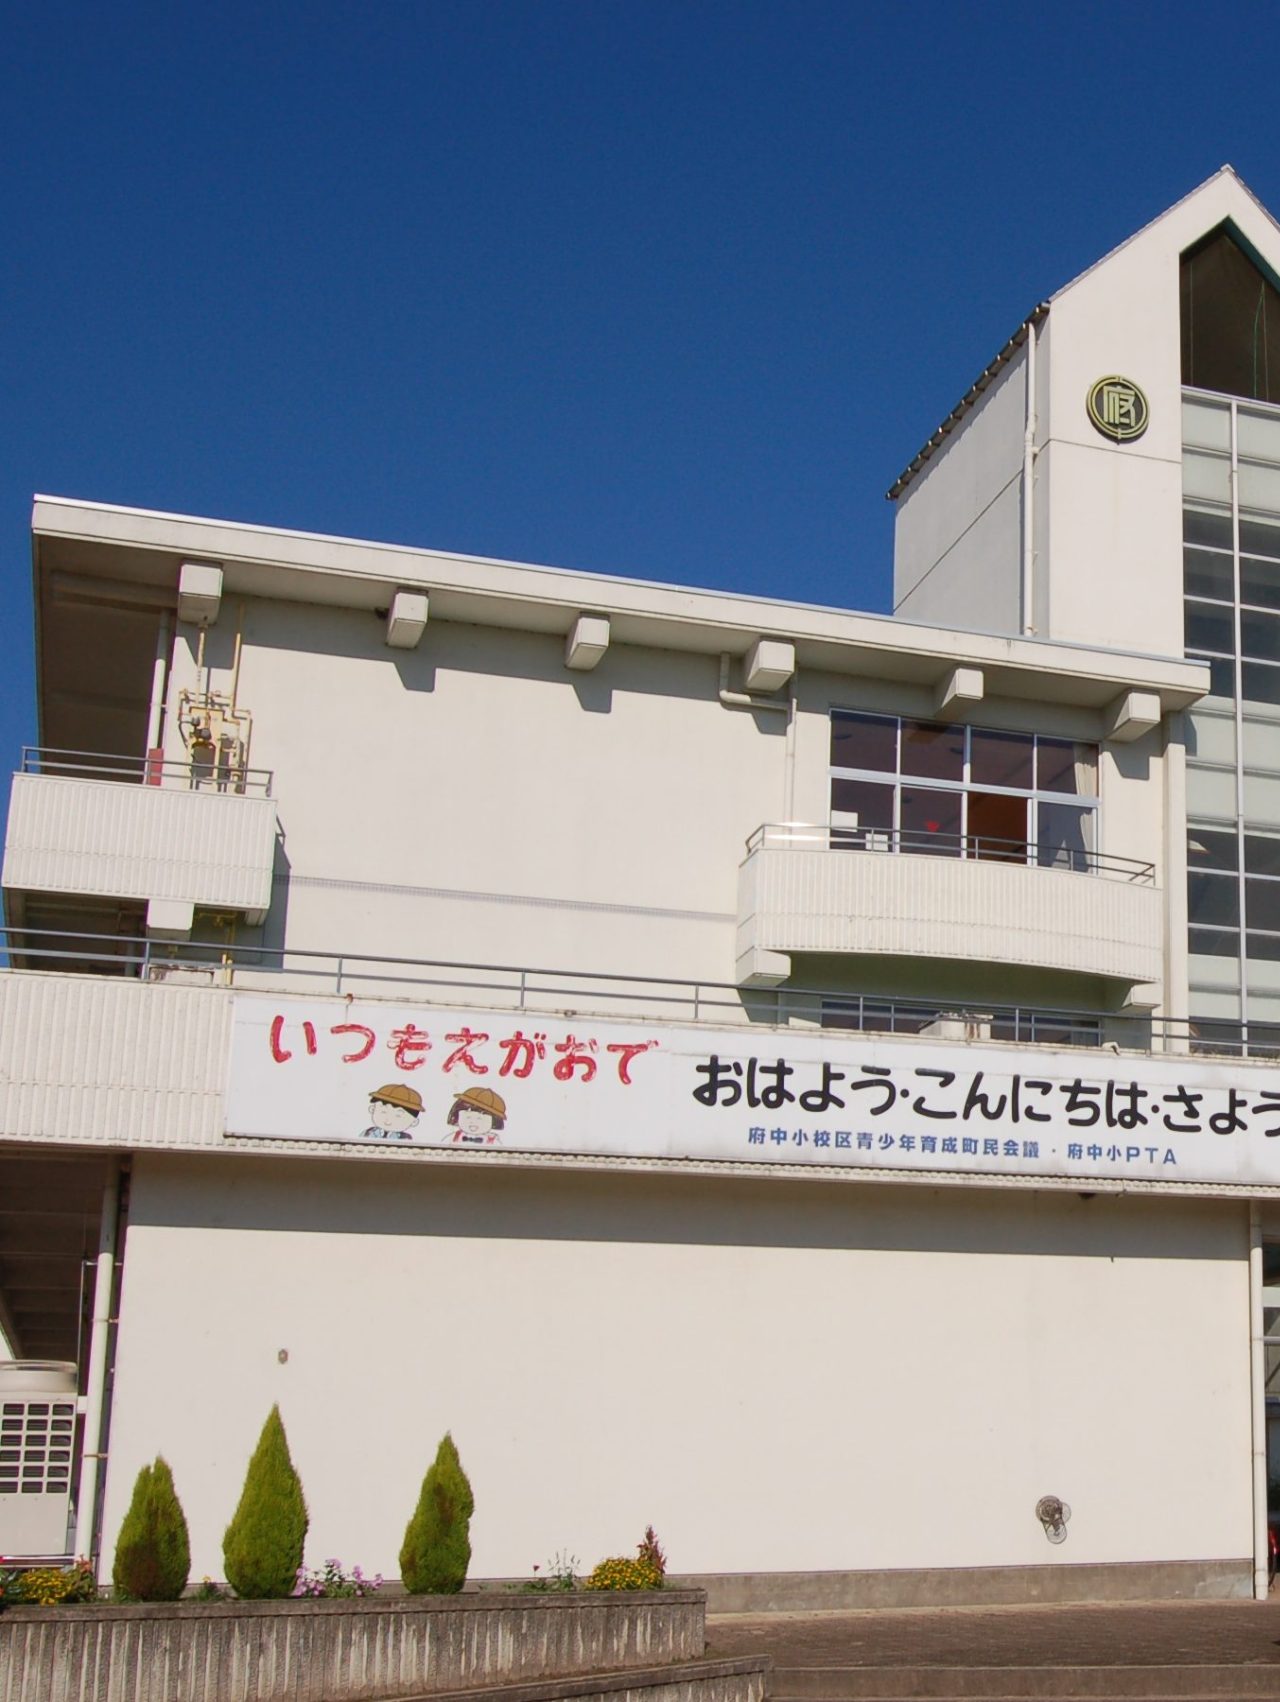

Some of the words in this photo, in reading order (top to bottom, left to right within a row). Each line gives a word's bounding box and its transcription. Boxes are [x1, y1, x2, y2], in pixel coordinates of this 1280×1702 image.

[270, 1014, 659, 1086] いつもえがおで
